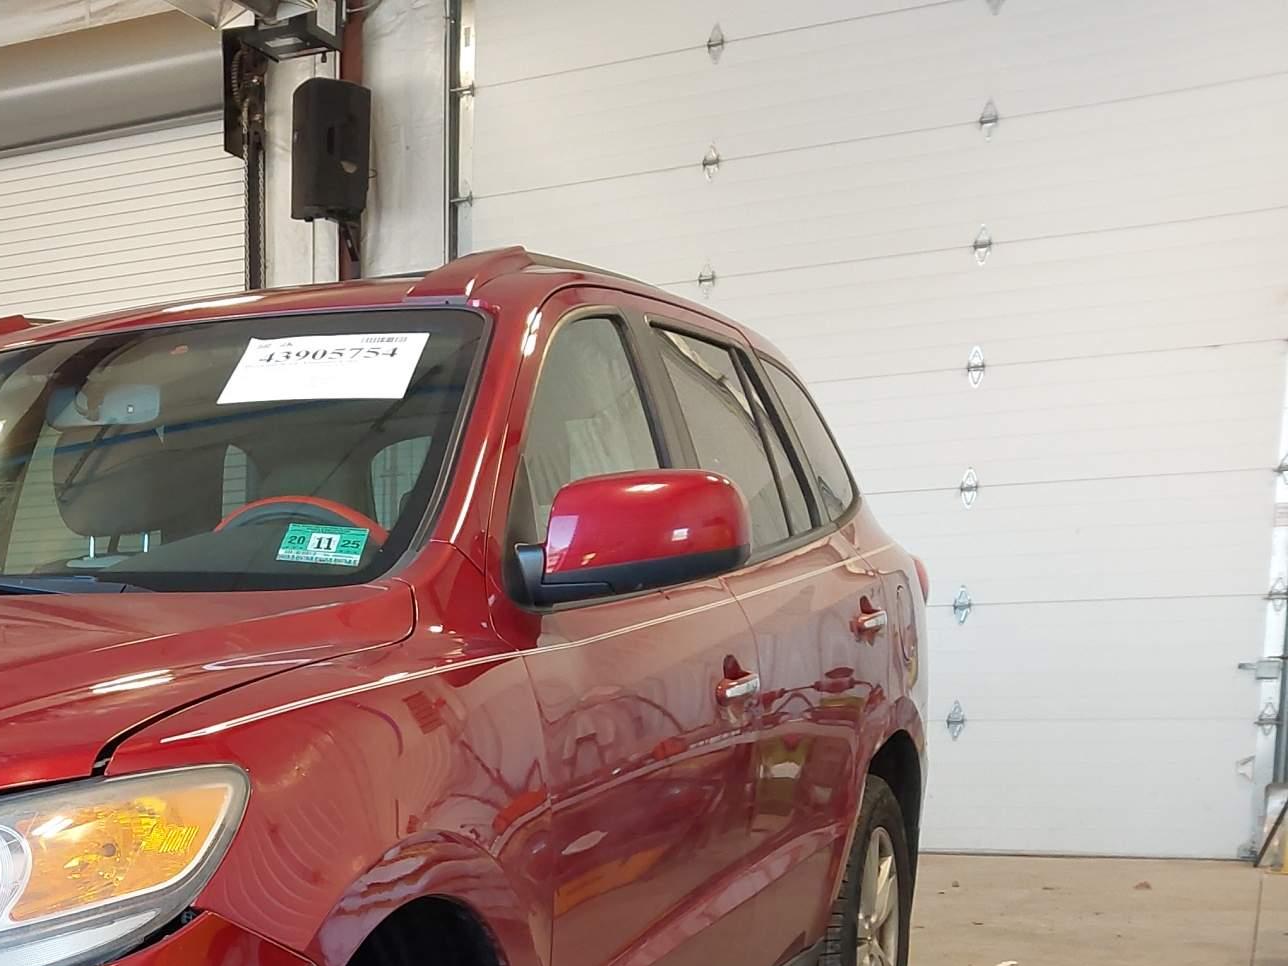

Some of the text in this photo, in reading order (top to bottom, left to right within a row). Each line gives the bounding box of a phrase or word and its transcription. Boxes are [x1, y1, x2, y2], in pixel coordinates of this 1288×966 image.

[259, 347, 398, 363] 43905754
[287, 535, 361, 550] 20 11 25
